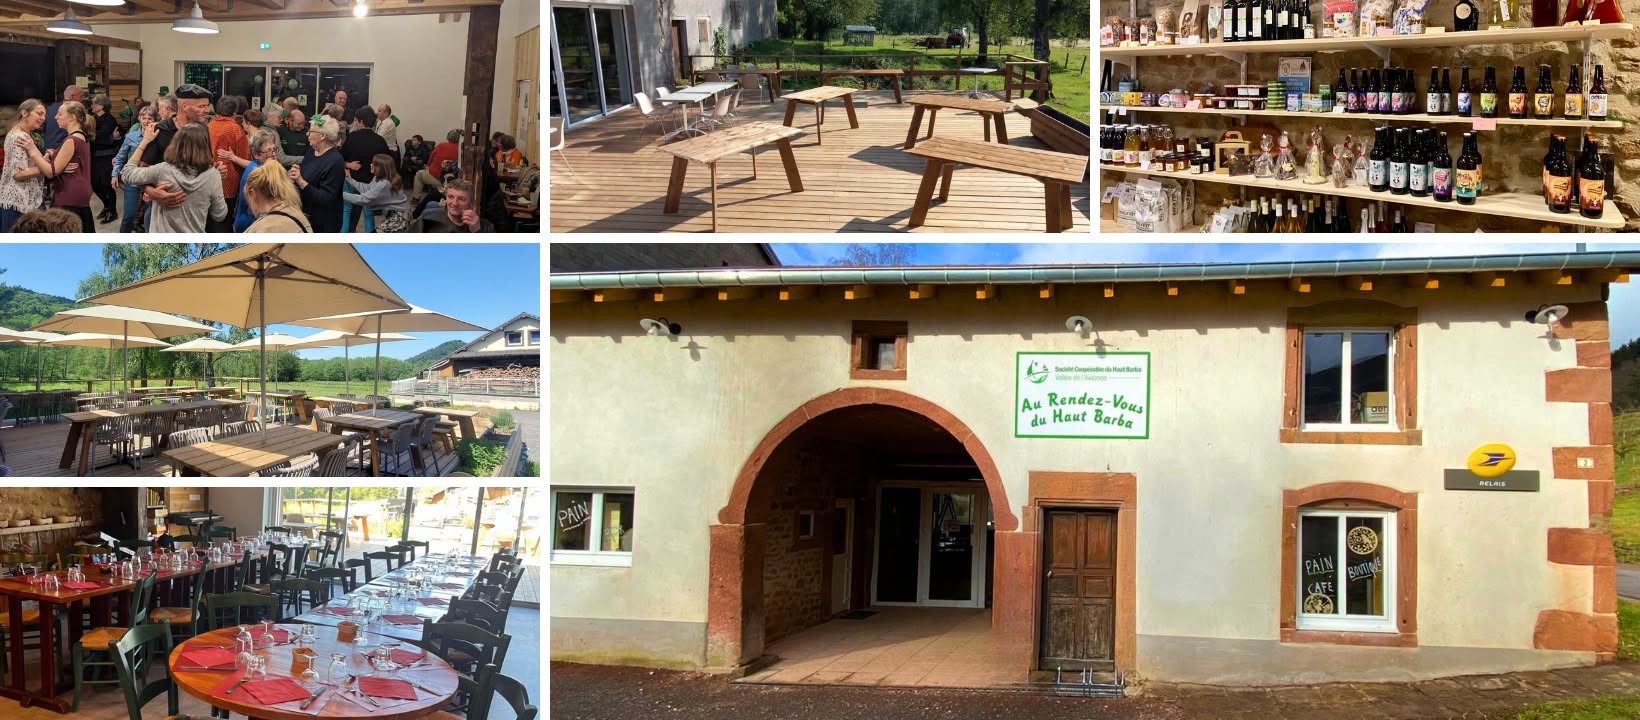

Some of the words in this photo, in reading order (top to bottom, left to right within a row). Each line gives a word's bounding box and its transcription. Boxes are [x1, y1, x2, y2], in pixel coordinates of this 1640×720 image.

[1022, 398, 1042, 413] Au
[1047, 392, 1143, 414] Rendez-Vous
[1031, 414, 1047, 427] du
[1053, 408, 1087, 423] Haut
[1094, 408, 1134, 429] Barba
[558, 501, 590, 527] PAIN
[1305, 554, 1333, 574] PAIN
[1348, 557, 1382, 578] BOUTIQUE
